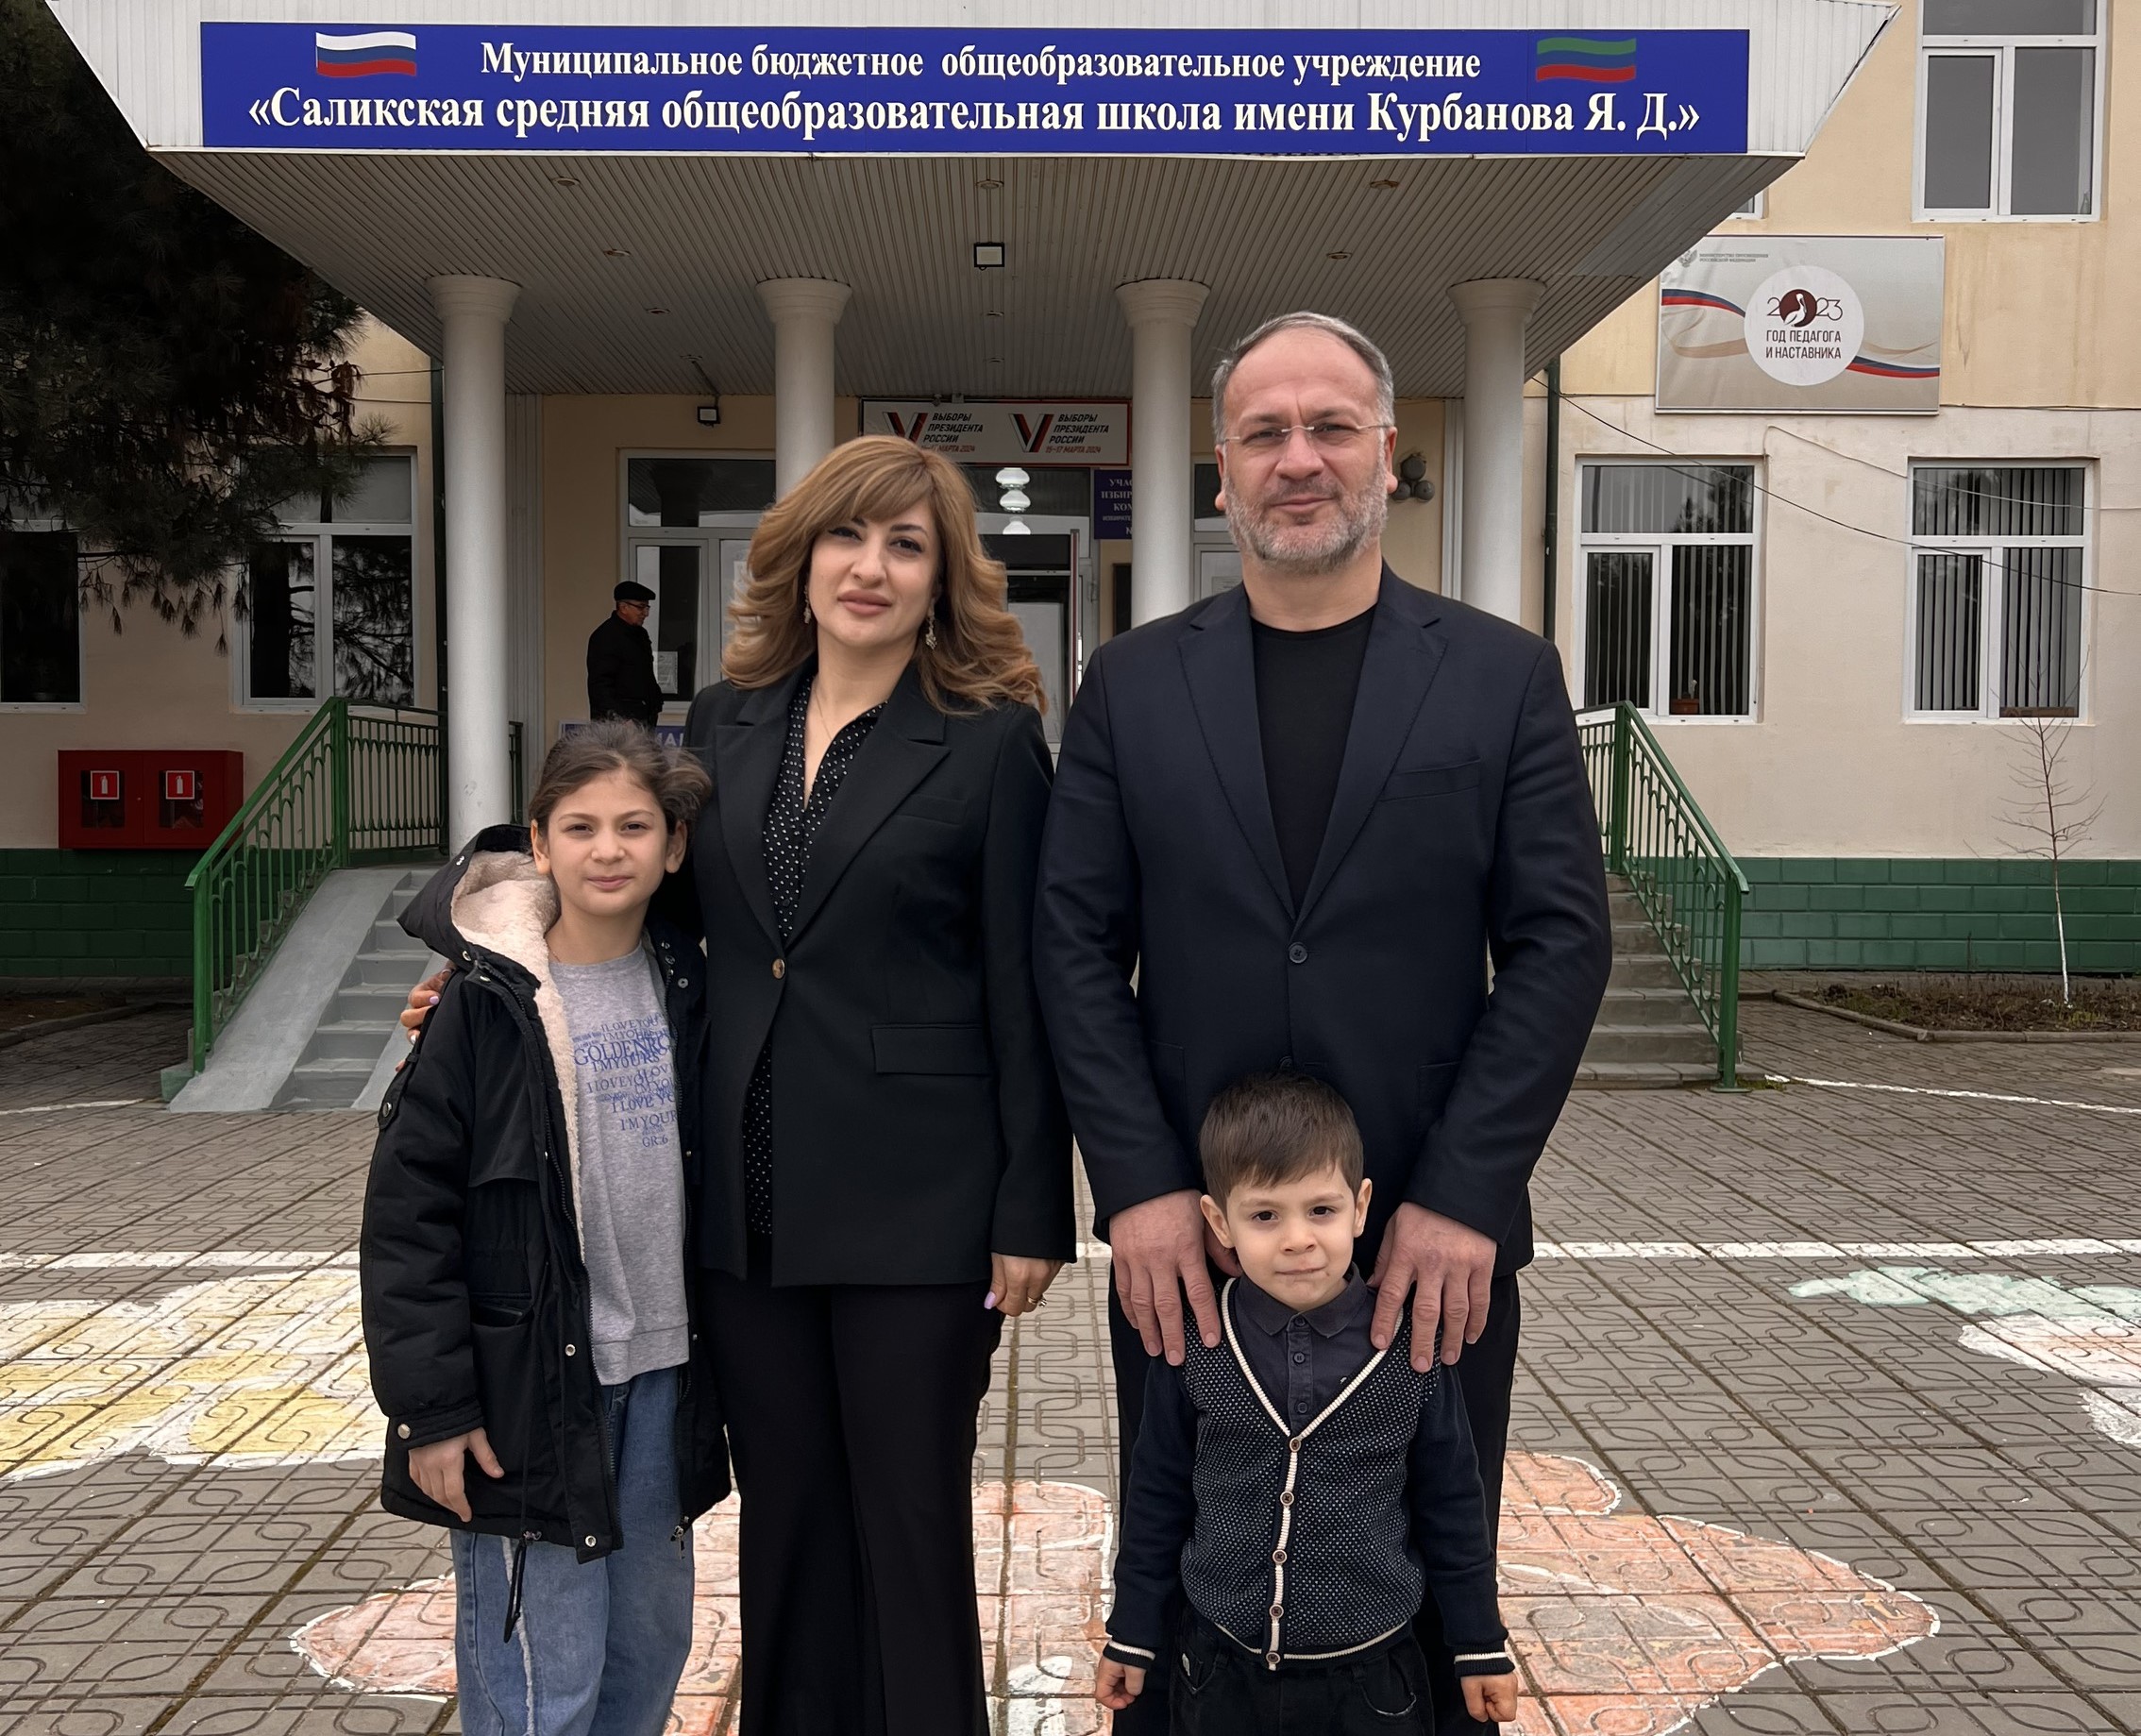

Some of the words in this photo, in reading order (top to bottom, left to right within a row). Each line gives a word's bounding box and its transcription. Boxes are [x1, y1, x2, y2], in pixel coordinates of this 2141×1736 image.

[480, 42, 743, 82] Муниципальное
[751, 44, 924, 79] бюджетное
[941, 45, 1285, 86] общеобразовательное
[1292, 54, 1481, 87] учреждение
[248, 87, 484, 126] «Саликская
[496, 98, 650, 139] средняя
[662, 90, 1085, 141] общеобразовательная
[1096, 102, 1222, 131] школа
[1233, 103, 1356, 131] имени
[1366, 92, 1576, 143] Курбанова
[1583, 93, 1627, 131] Я.
[1636, 93, 1700, 141] Д.»
[1766, 329, 1786, 343] ГОД
[1790, 330, 1842, 343] ПЕДАГОГА
[1765, 346, 1773, 359] И
[1775, 346, 1842, 359] НАСТАВНИКА
[932, 413, 972, 422] ВЫБОРЫ
[1057, 413, 1098, 423] ВЫБОРЫ
[927, 423, 984, 432] ПРЕЗИДЕНТА
[1053, 424, 1109, 434] ПРЕЗИДЕНТА
[923, 434, 959, 443] РОССИИ
[1049, 435, 1085, 444] РОССИИ
